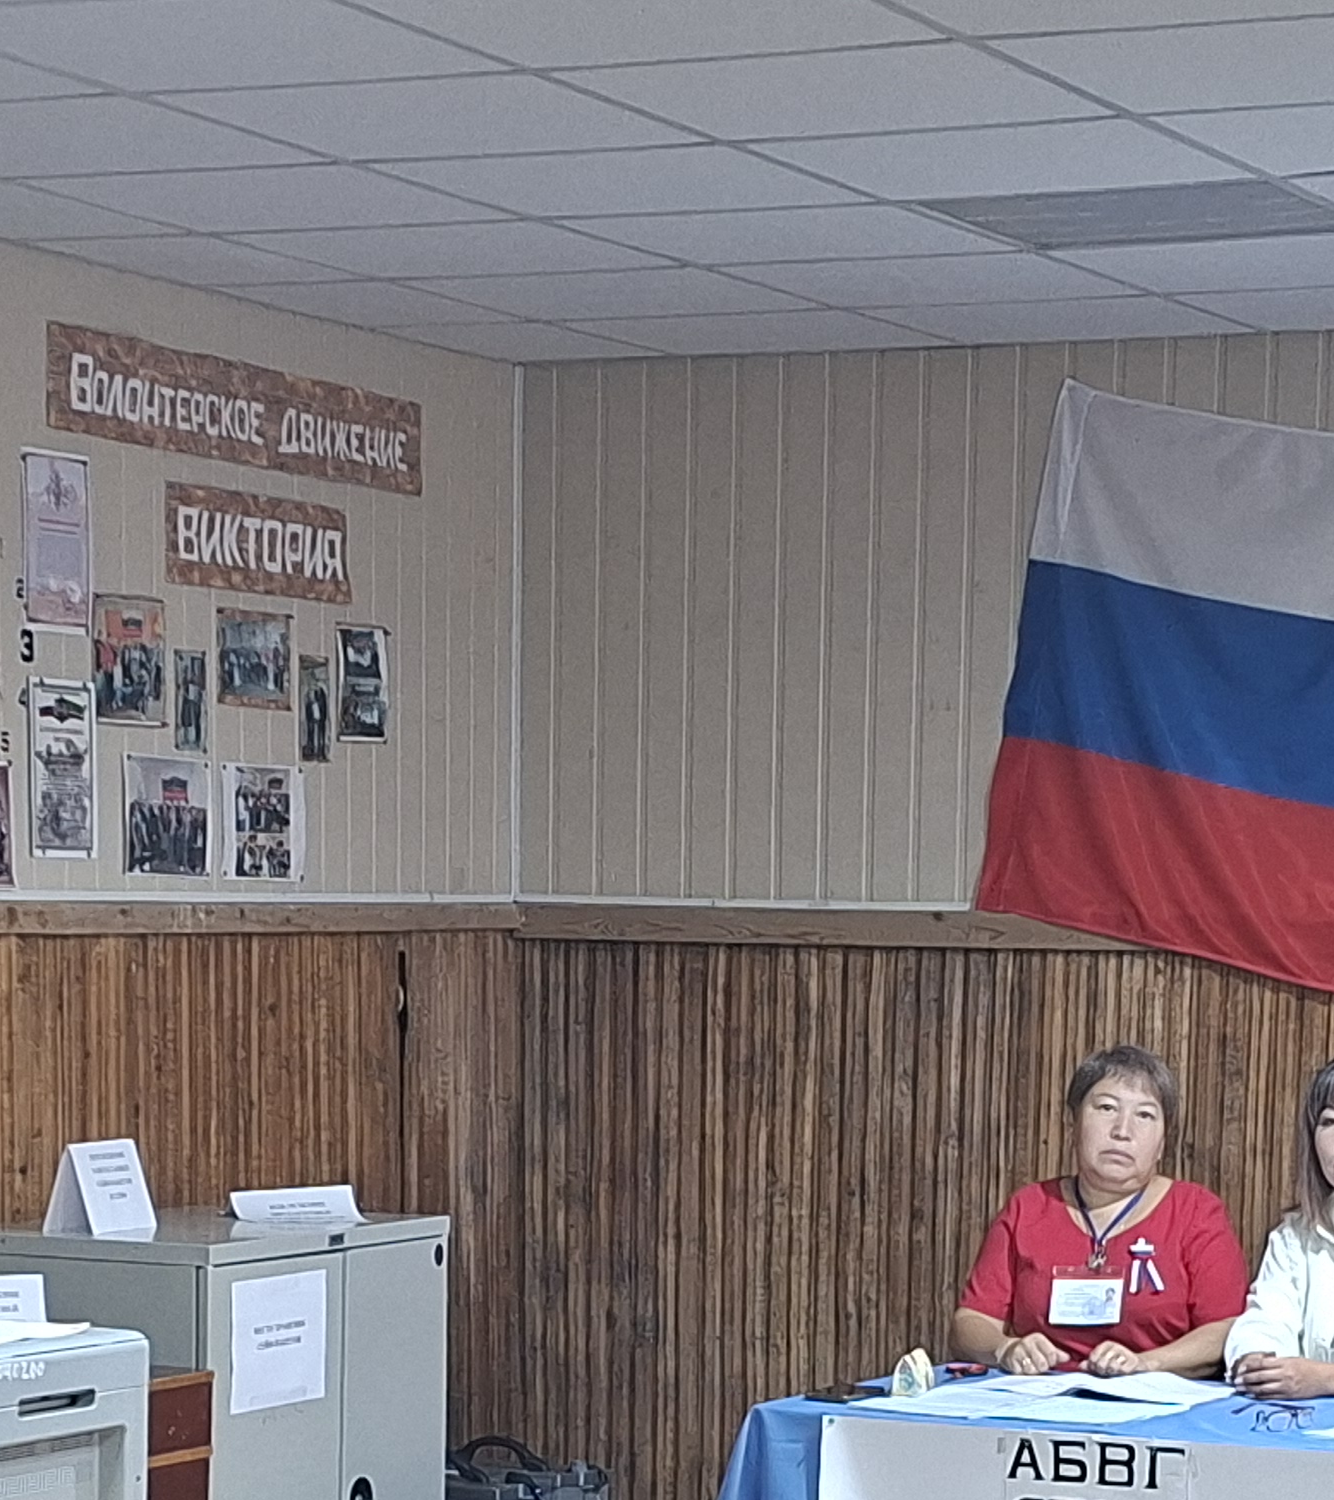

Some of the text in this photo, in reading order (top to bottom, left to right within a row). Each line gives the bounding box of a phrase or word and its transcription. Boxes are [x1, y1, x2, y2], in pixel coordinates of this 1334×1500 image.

[70, 352, 408, 472] ВОЛОНТЕРСКОЕ ДВИЖЕНИЕ
[178, 505, 343, 581] ВИКТОРИЯ
[20, 629, 34, 662] 3
[1007, 1438, 1185, 1489] АБВГ
